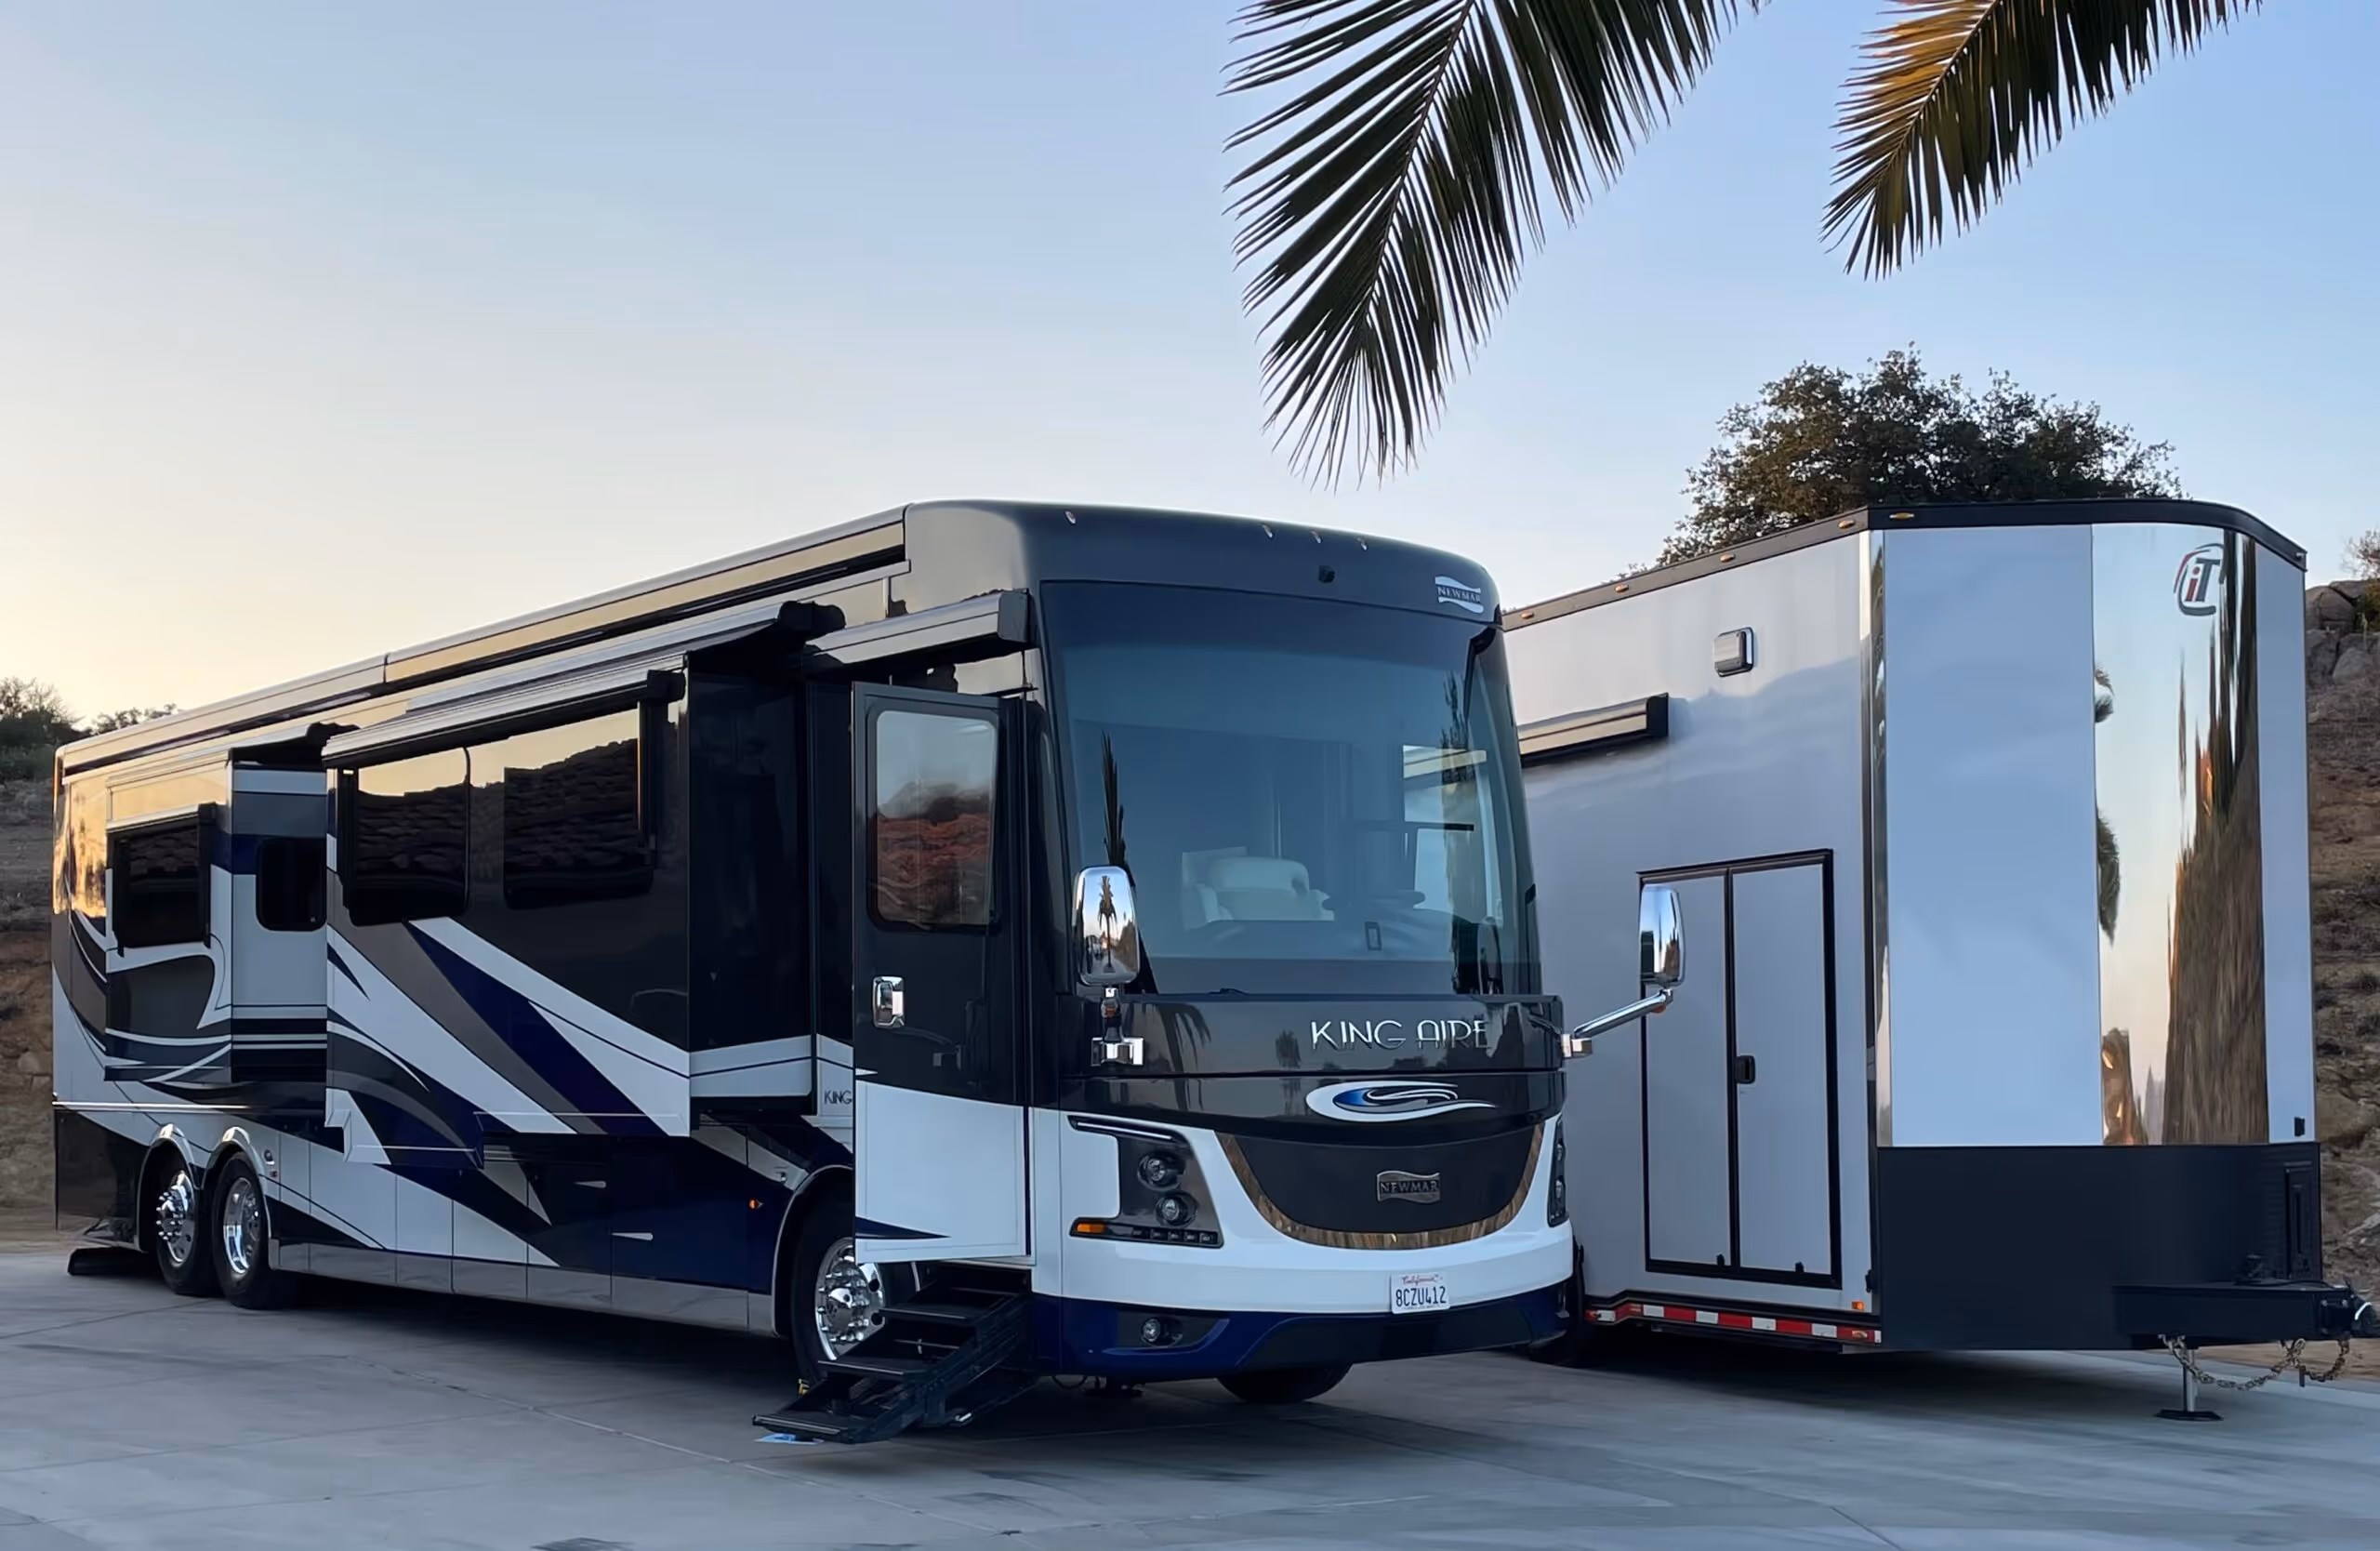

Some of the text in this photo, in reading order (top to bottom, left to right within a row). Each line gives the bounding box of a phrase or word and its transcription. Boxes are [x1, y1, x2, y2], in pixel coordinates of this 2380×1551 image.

[1437, 586, 1481, 602] NEWMAR
[1311, 1019, 1491, 1050] KING AIRE
[824, 1090, 853, 1105] KING
[1380, 1180, 1439, 1193] NEWMAR
[1395, 1286, 1447, 1307] 8CZU412
